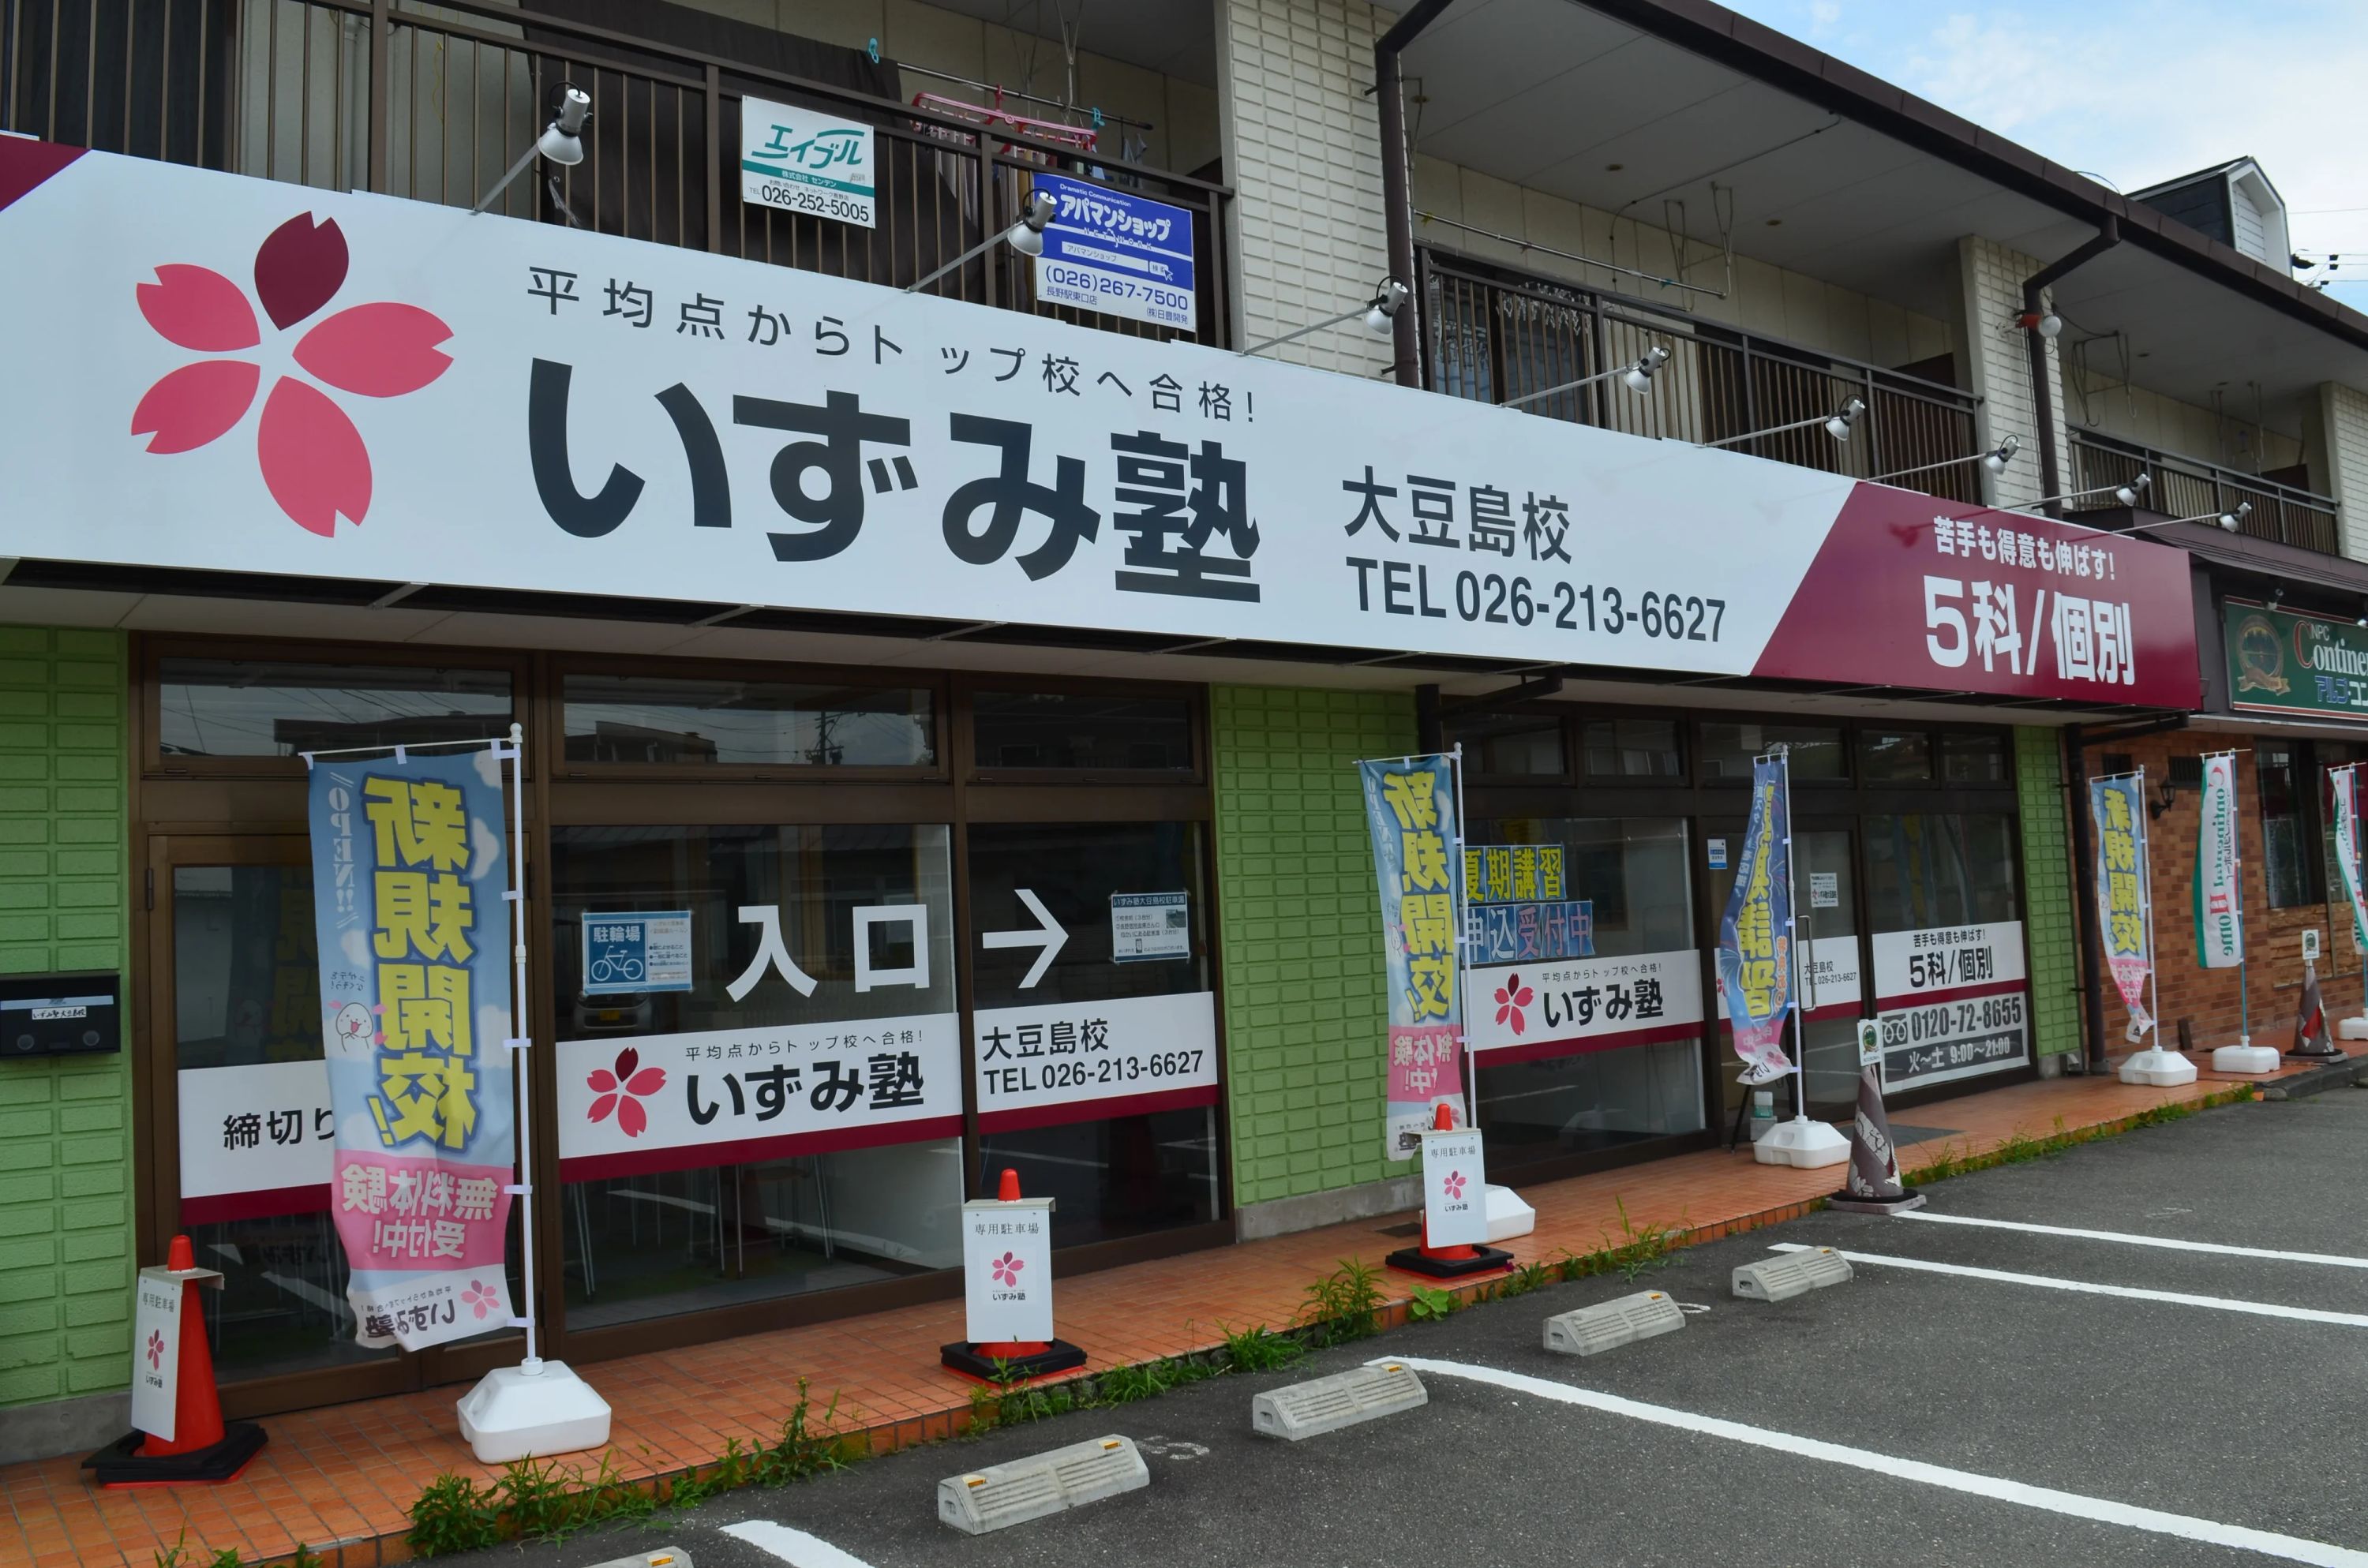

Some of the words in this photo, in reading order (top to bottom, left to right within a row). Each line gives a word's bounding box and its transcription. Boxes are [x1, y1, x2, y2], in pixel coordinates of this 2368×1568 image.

[751, 124, 865, 169] エイブル
[781, 170, 809, 182] 株式会社
[811, 177, 837, 188] センデン
[1059, 183, 1088, 196] Dramatic
[1088, 190, 1131, 208] Communication
[762, 185, 869, 222] 026-252-5005
[1060, 194, 1171, 241] アパマンショップ
[1066, 245, 1117, 262] アパマンショップ
[1046, 265, 1189, 311] (026)267-7500
[1047, 286, 1097, 306] 長野駅東口店
[527, 265, 1254, 424] 平均点からトップ校へ合格!
[528, 357, 1261, 604] いずみ塾
[1342, 465, 1572, 564] 大豆島校
[1933, 515, 2115, 581] 苦手も得意も伸ばす!
[1923, 574, 2136, 686] 5科/個別
[2311, 624, 2330, 642] NPC
[593, 926, 641, 943] 駐輪場
[725, 904, 930, 1003] 入口
[1913, 928, 1986, 948] 苦手も得意も伸ばす!
[1909, 945, 1994, 988] 5科/個別
[1543, 978, 1664, 1028] いずみ塾
[1911, 996, 2022, 1042] 0120-72-8655
[685, 1030, 923, 1061] 平均点からトップ校へ合格!
[982, 1018, 1109, 1062] 大豆島校
[687, 1051, 924, 1125] いずみ塾
[1430, 1145, 1476, 1158] 専用駐車場
[975, 1222, 1040, 1235] 専用駐車場
[1444, 1203, 1469, 1212] いずみ塾
[992, 1292, 1026, 1300] いずみ塾
